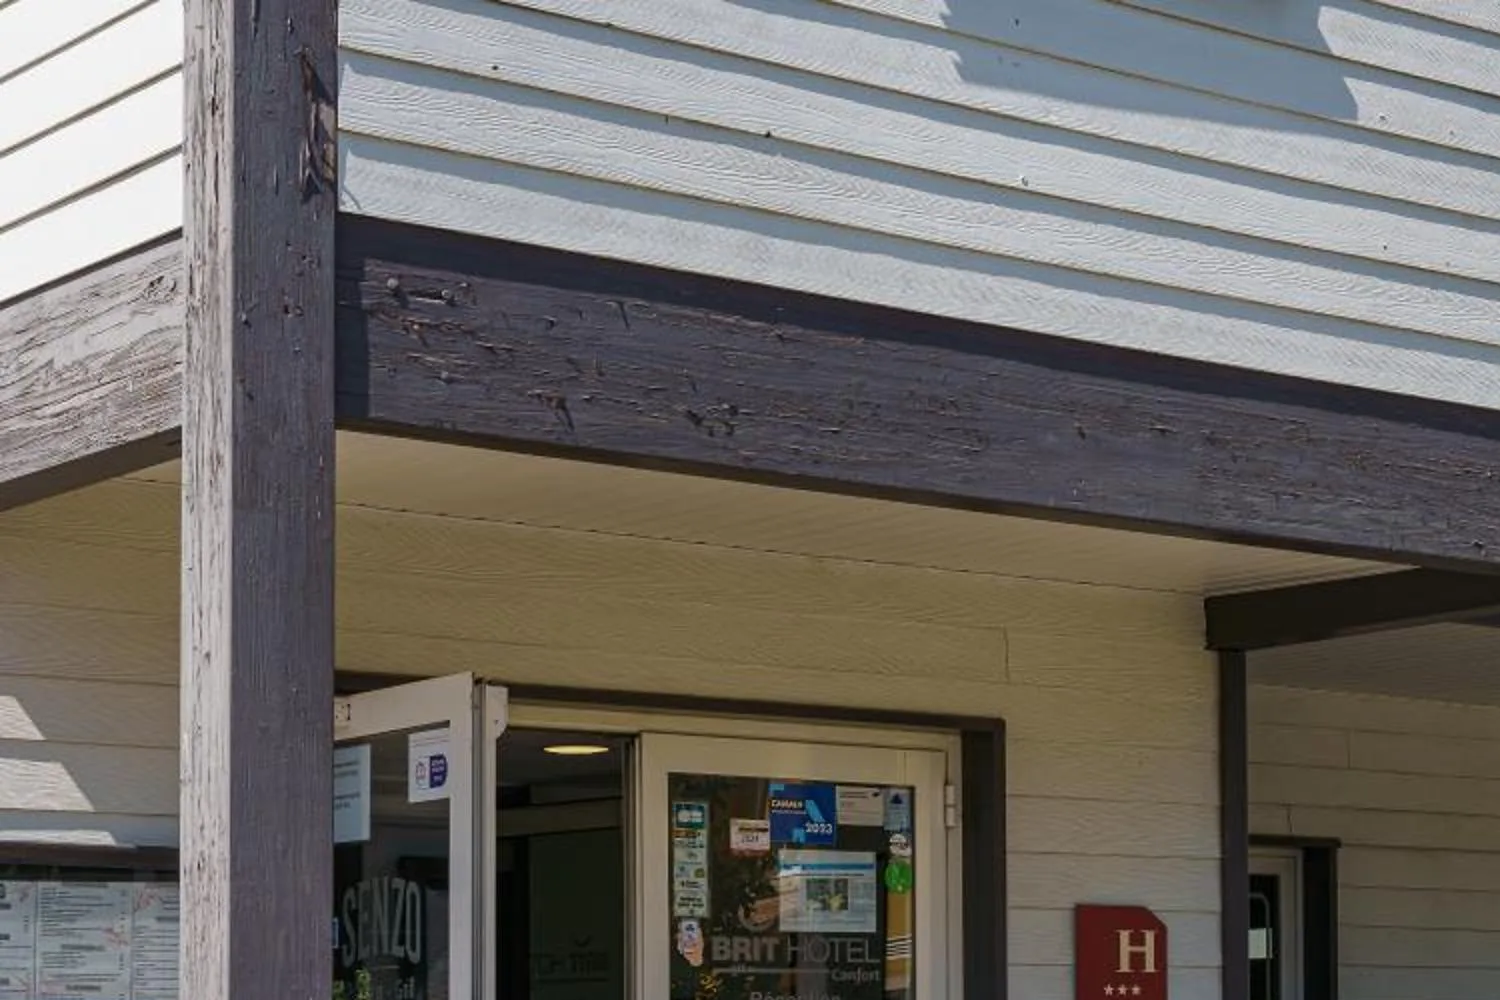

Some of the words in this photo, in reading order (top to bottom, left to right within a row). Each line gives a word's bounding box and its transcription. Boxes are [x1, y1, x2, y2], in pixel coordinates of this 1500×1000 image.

[341, 876, 422, 968] SENZO
[713, 936, 779, 962] BRIT
[787, 934, 881, 963] HOTEL
[1115, 929, 1159, 973] H
[831, 967, 881, 984] Confort
